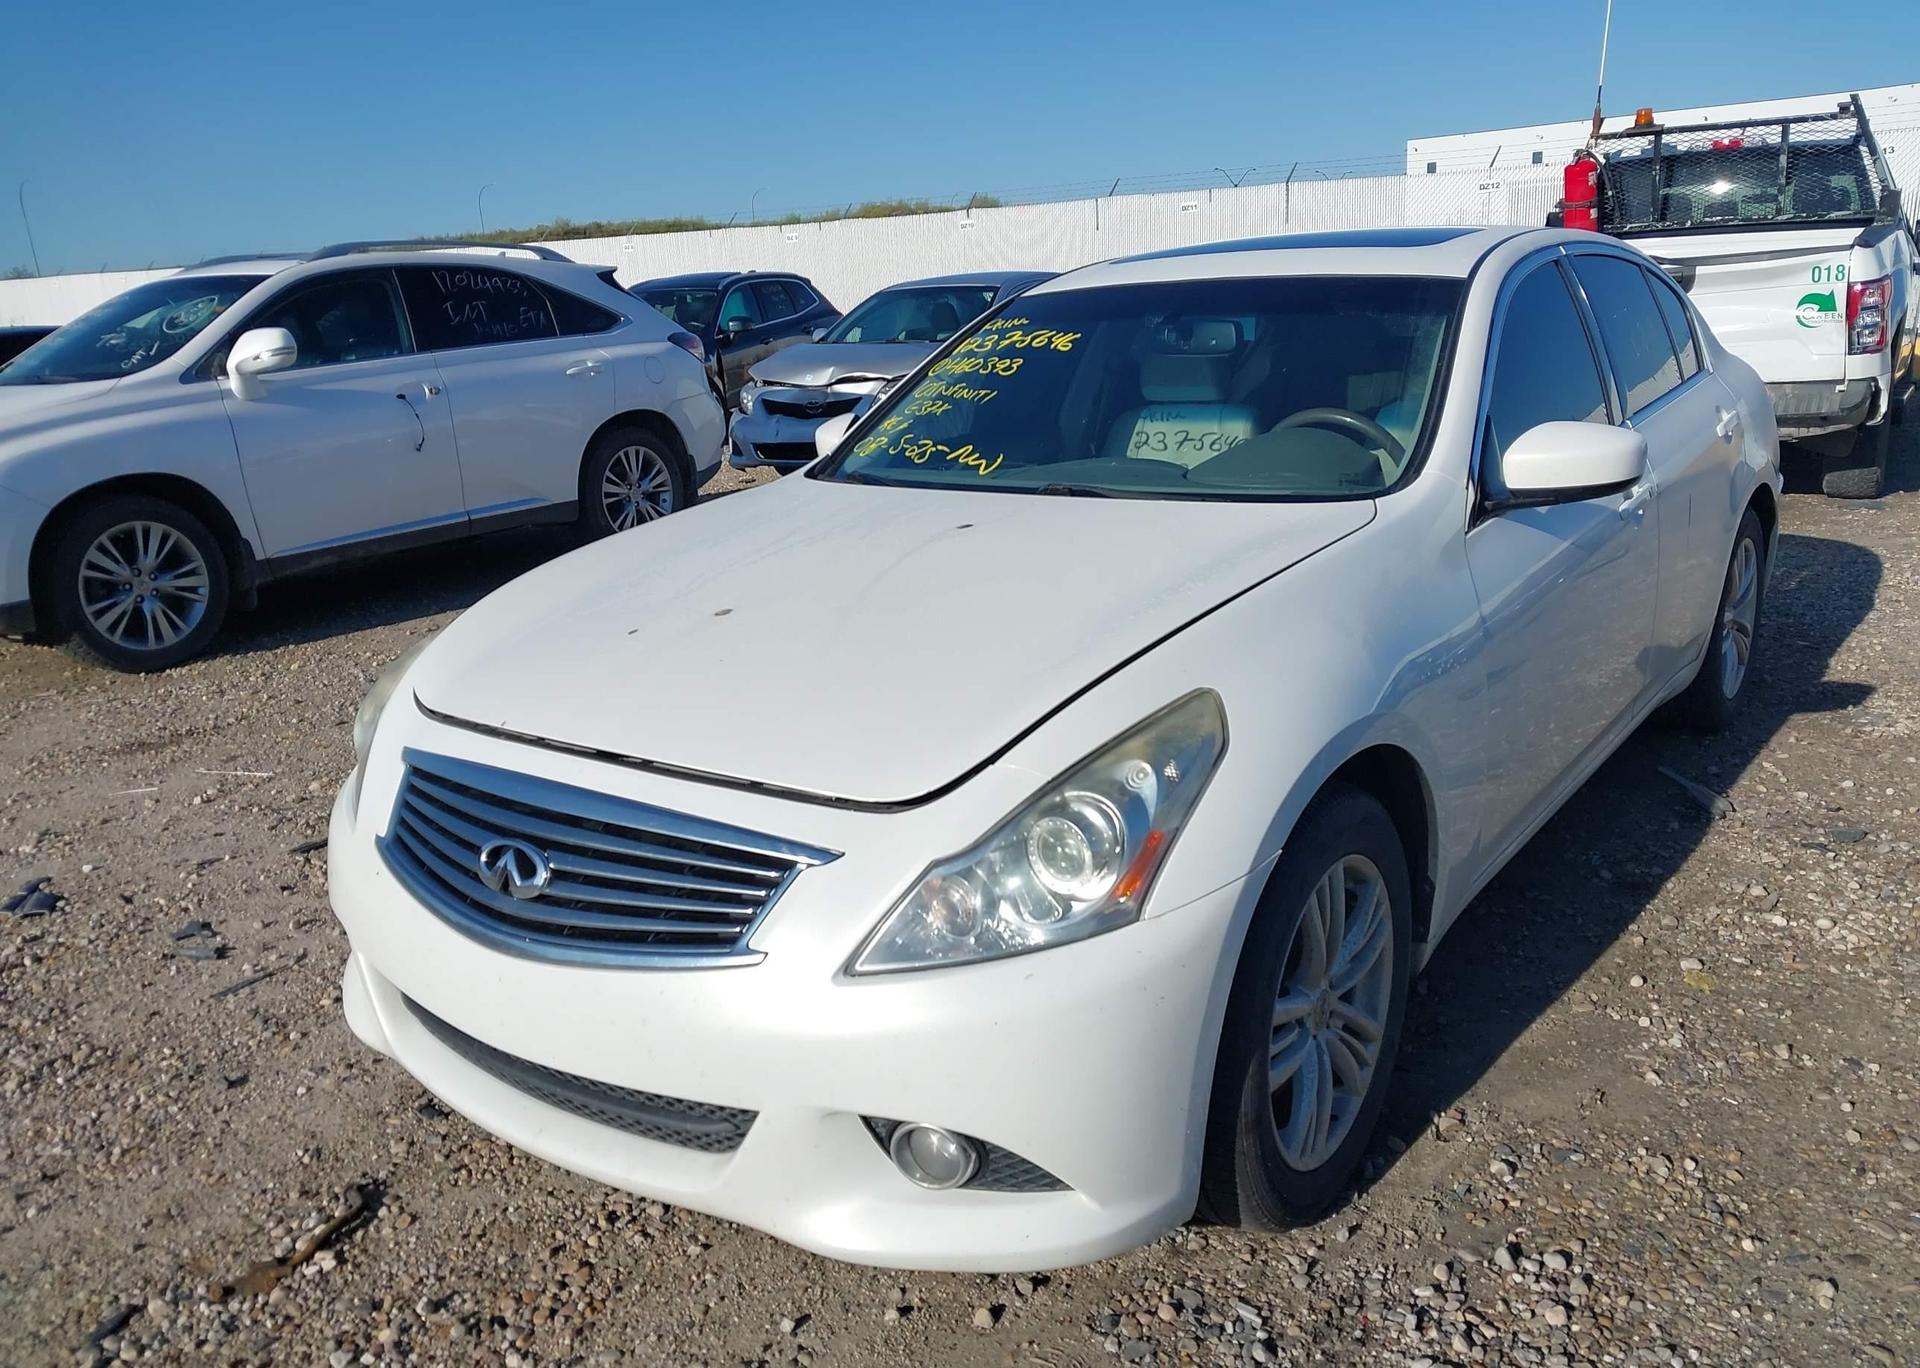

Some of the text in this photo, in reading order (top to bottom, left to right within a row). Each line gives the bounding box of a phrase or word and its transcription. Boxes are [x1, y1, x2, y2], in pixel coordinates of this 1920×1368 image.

[1881, 146, 1895, 155] 13
[1480, 182, 1501, 190] DZ12
[1811, 264, 1846, 283] 018
